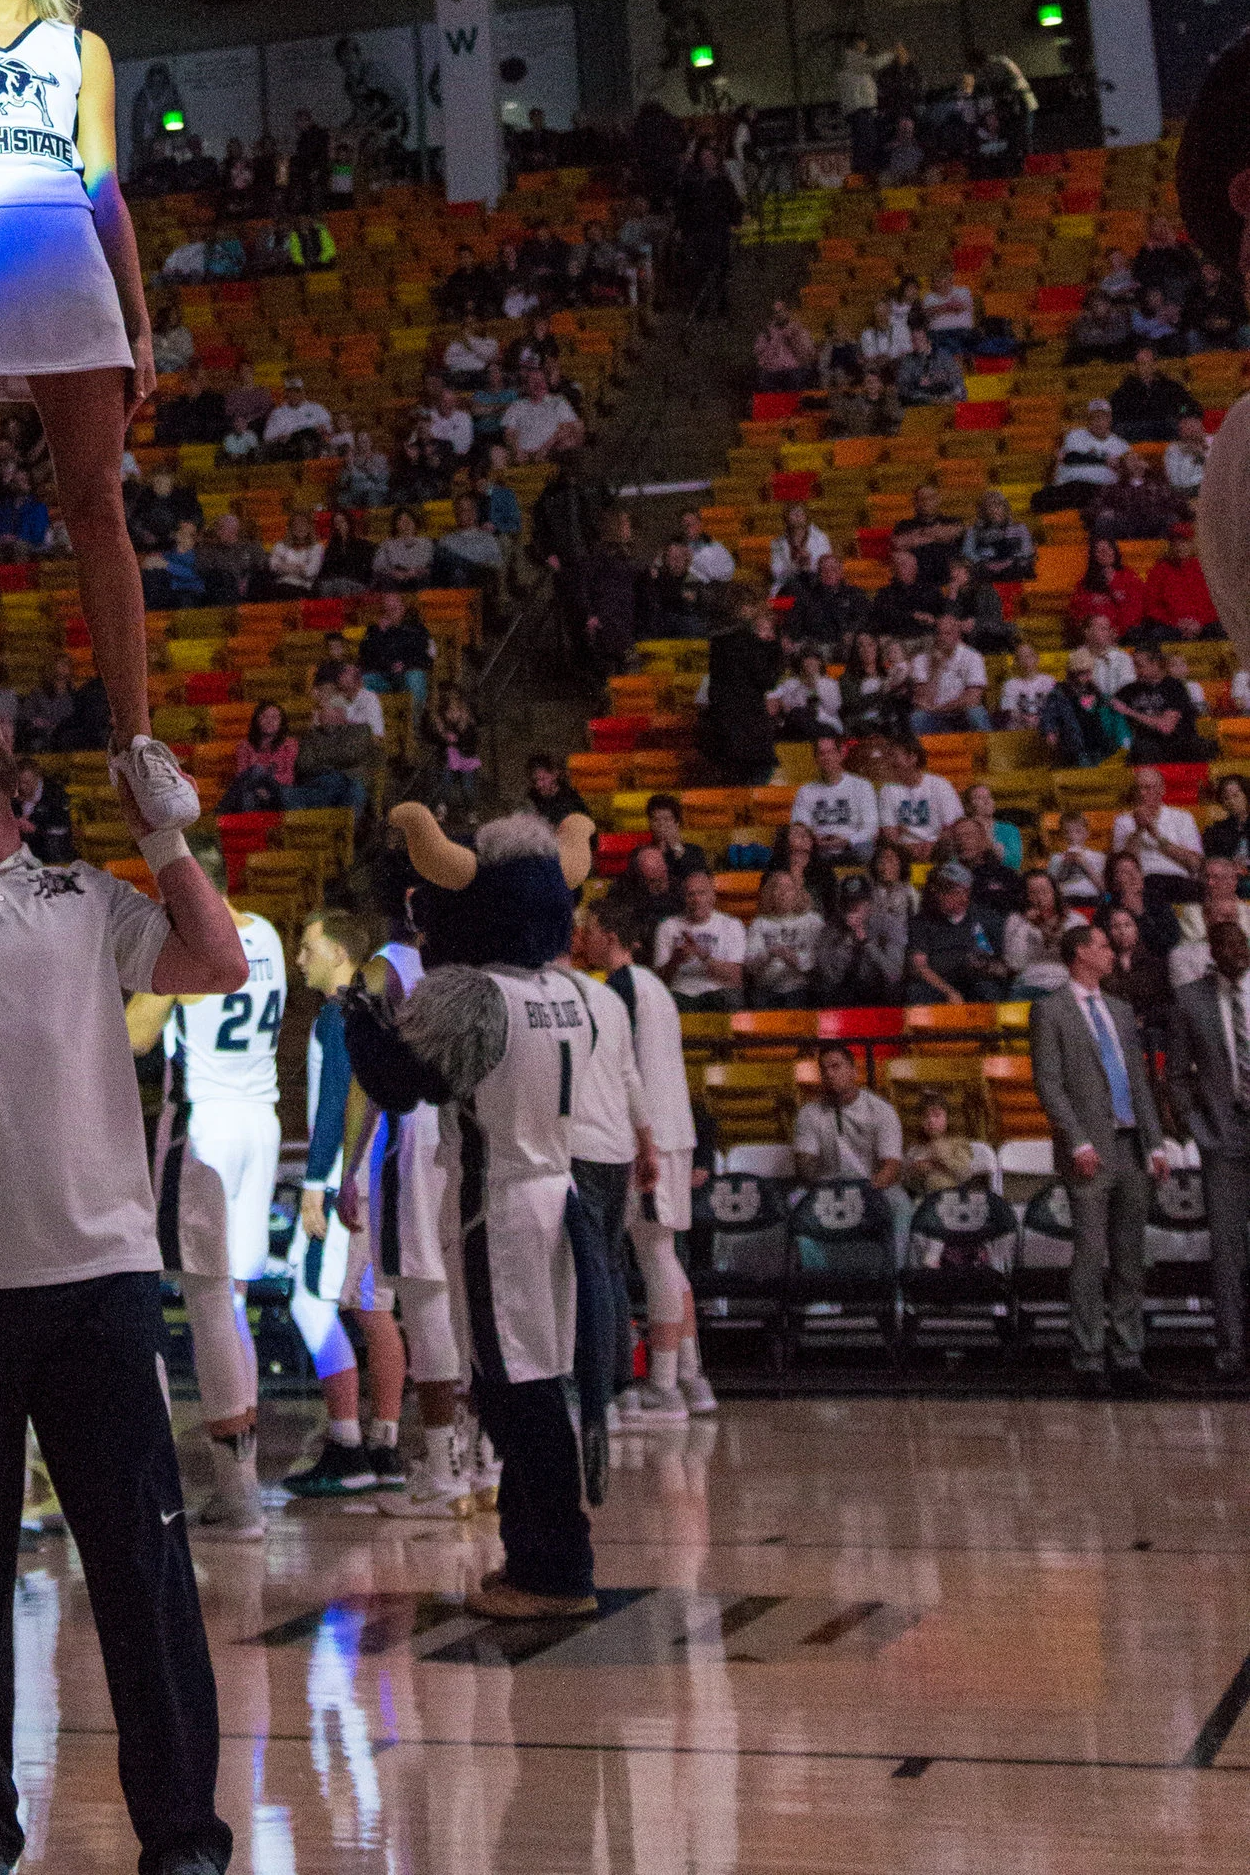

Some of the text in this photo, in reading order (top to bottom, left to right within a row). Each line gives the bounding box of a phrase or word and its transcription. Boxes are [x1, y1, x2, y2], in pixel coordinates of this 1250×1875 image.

[445, 26, 479, 55] W
[11, 126, 73, 168] STATE
[215, 990, 281, 1052] 24
[558, 1039, 572, 1117] 1
